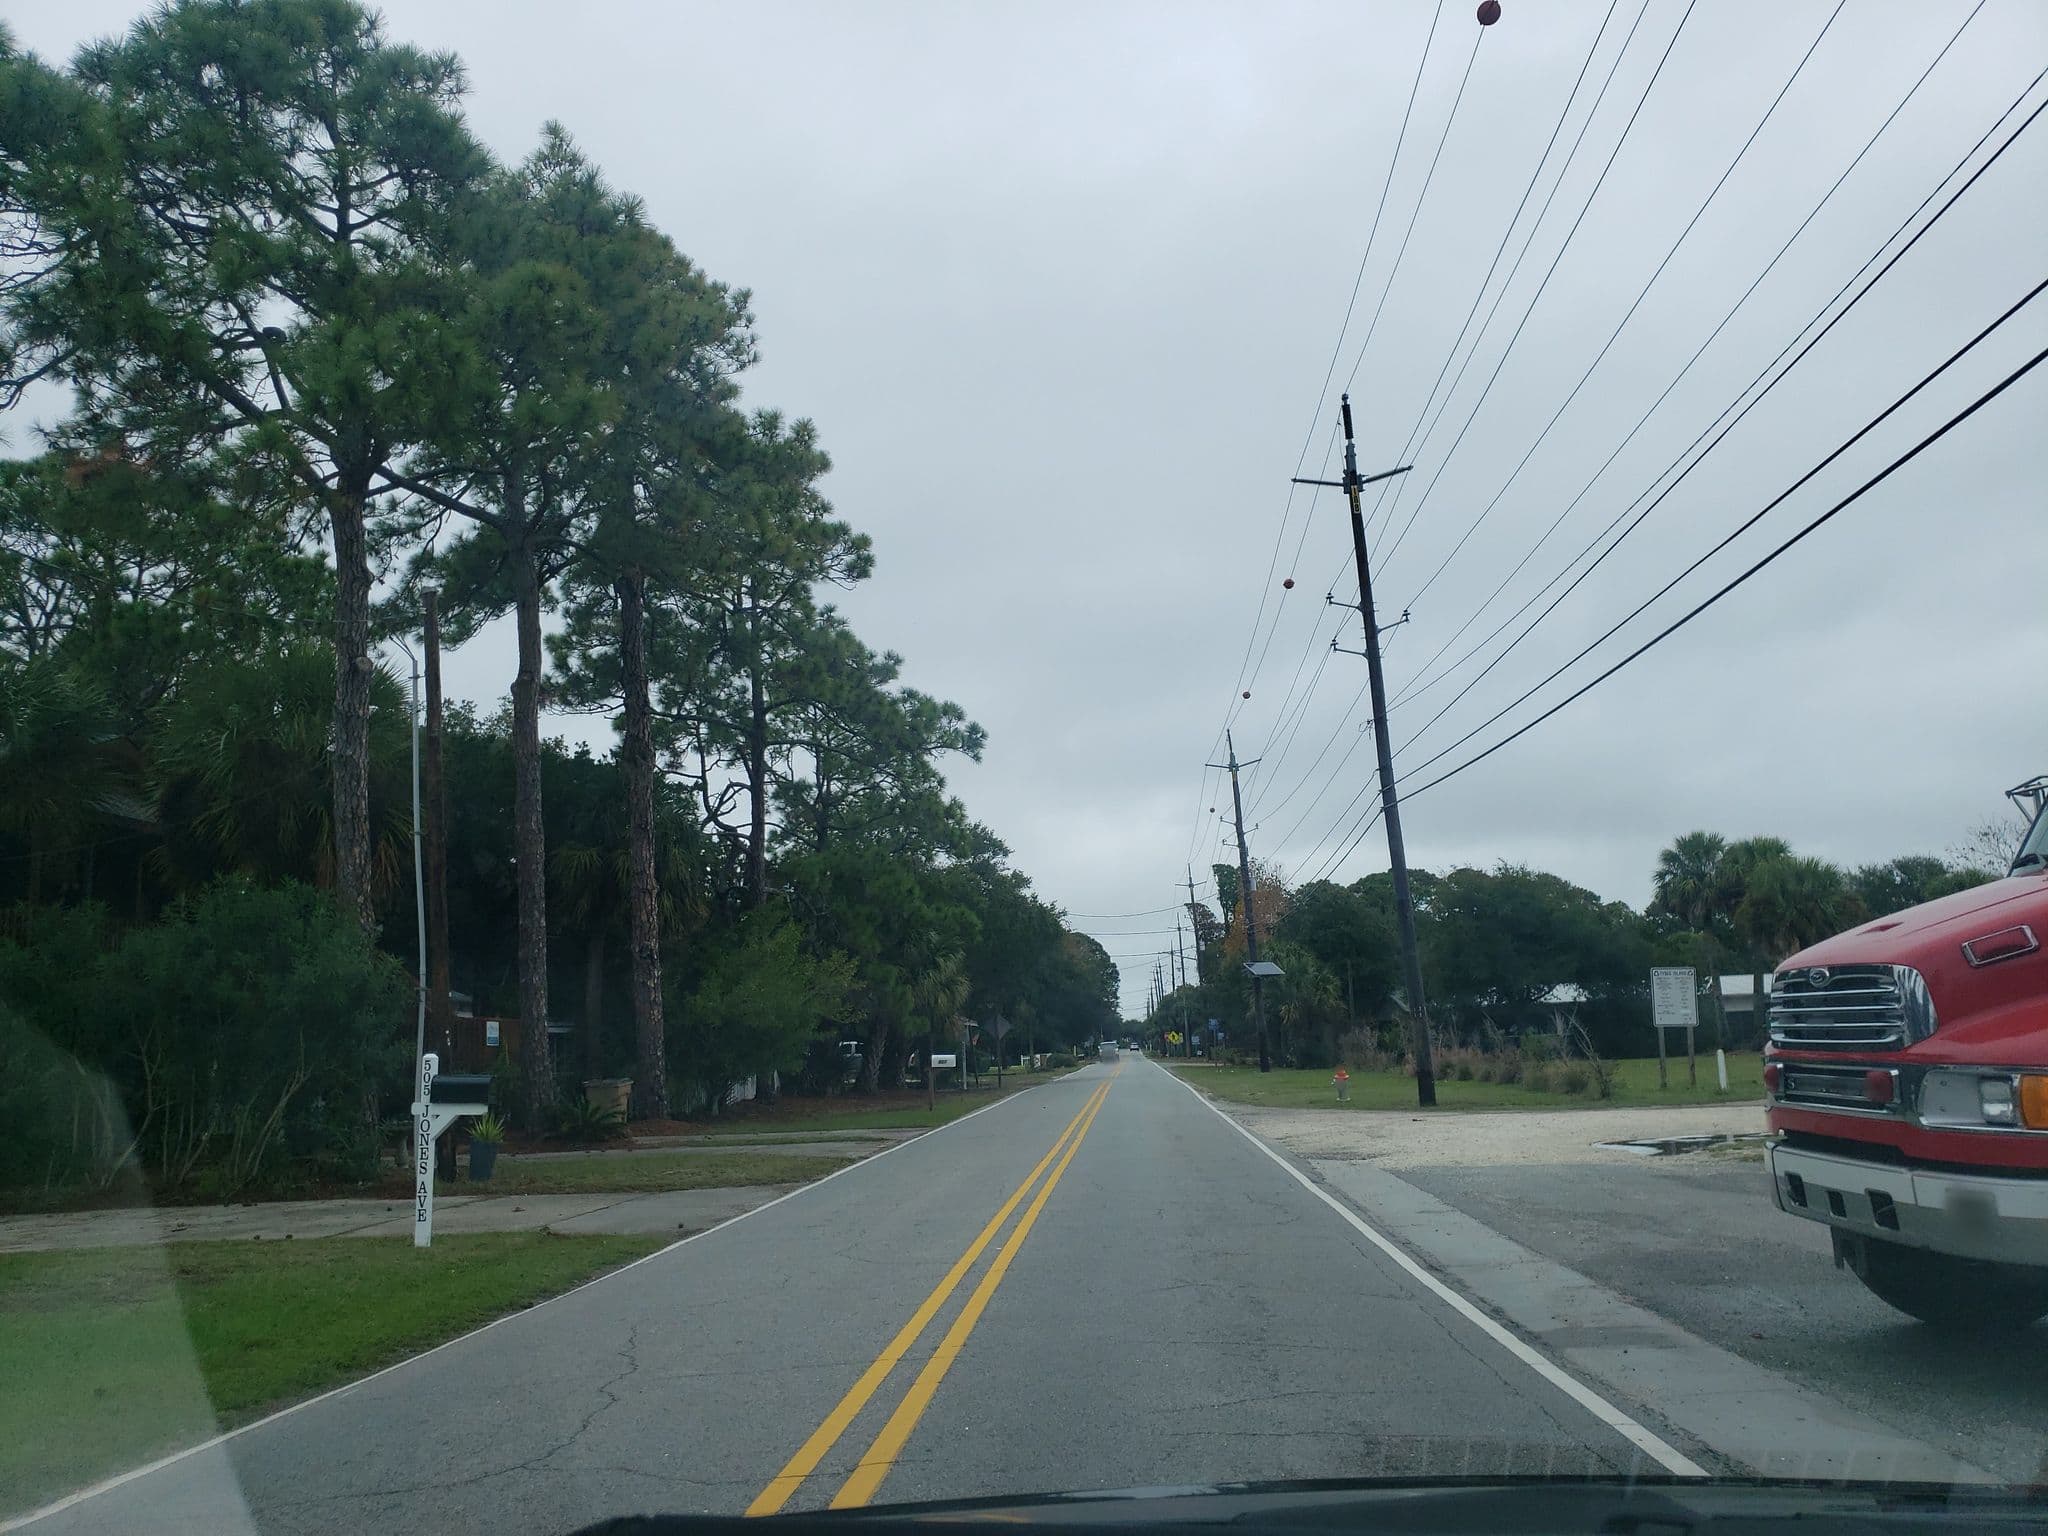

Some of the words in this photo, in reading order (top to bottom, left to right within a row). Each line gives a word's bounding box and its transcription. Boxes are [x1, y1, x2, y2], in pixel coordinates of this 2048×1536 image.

[423, 1059, 431, 1096] 505
[420, 1105, 430, 1175] JONES
[417, 1181, 427, 1222] AVE
